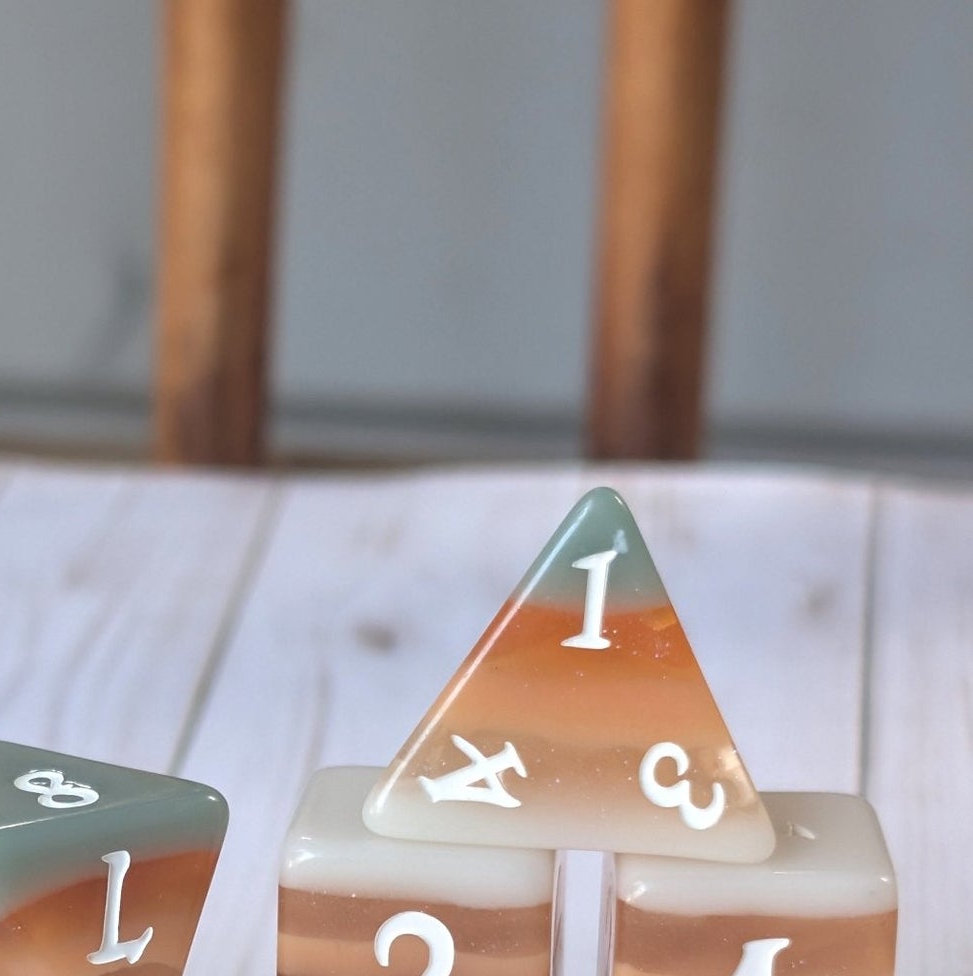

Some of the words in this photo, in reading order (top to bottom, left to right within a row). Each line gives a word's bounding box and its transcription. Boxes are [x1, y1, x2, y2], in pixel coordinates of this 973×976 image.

[561, 550, 617, 650] 1
[14, 769, 99, 808] 8
[417, 734, 527, 808] 4
[639, 742, 725, 830] 3
